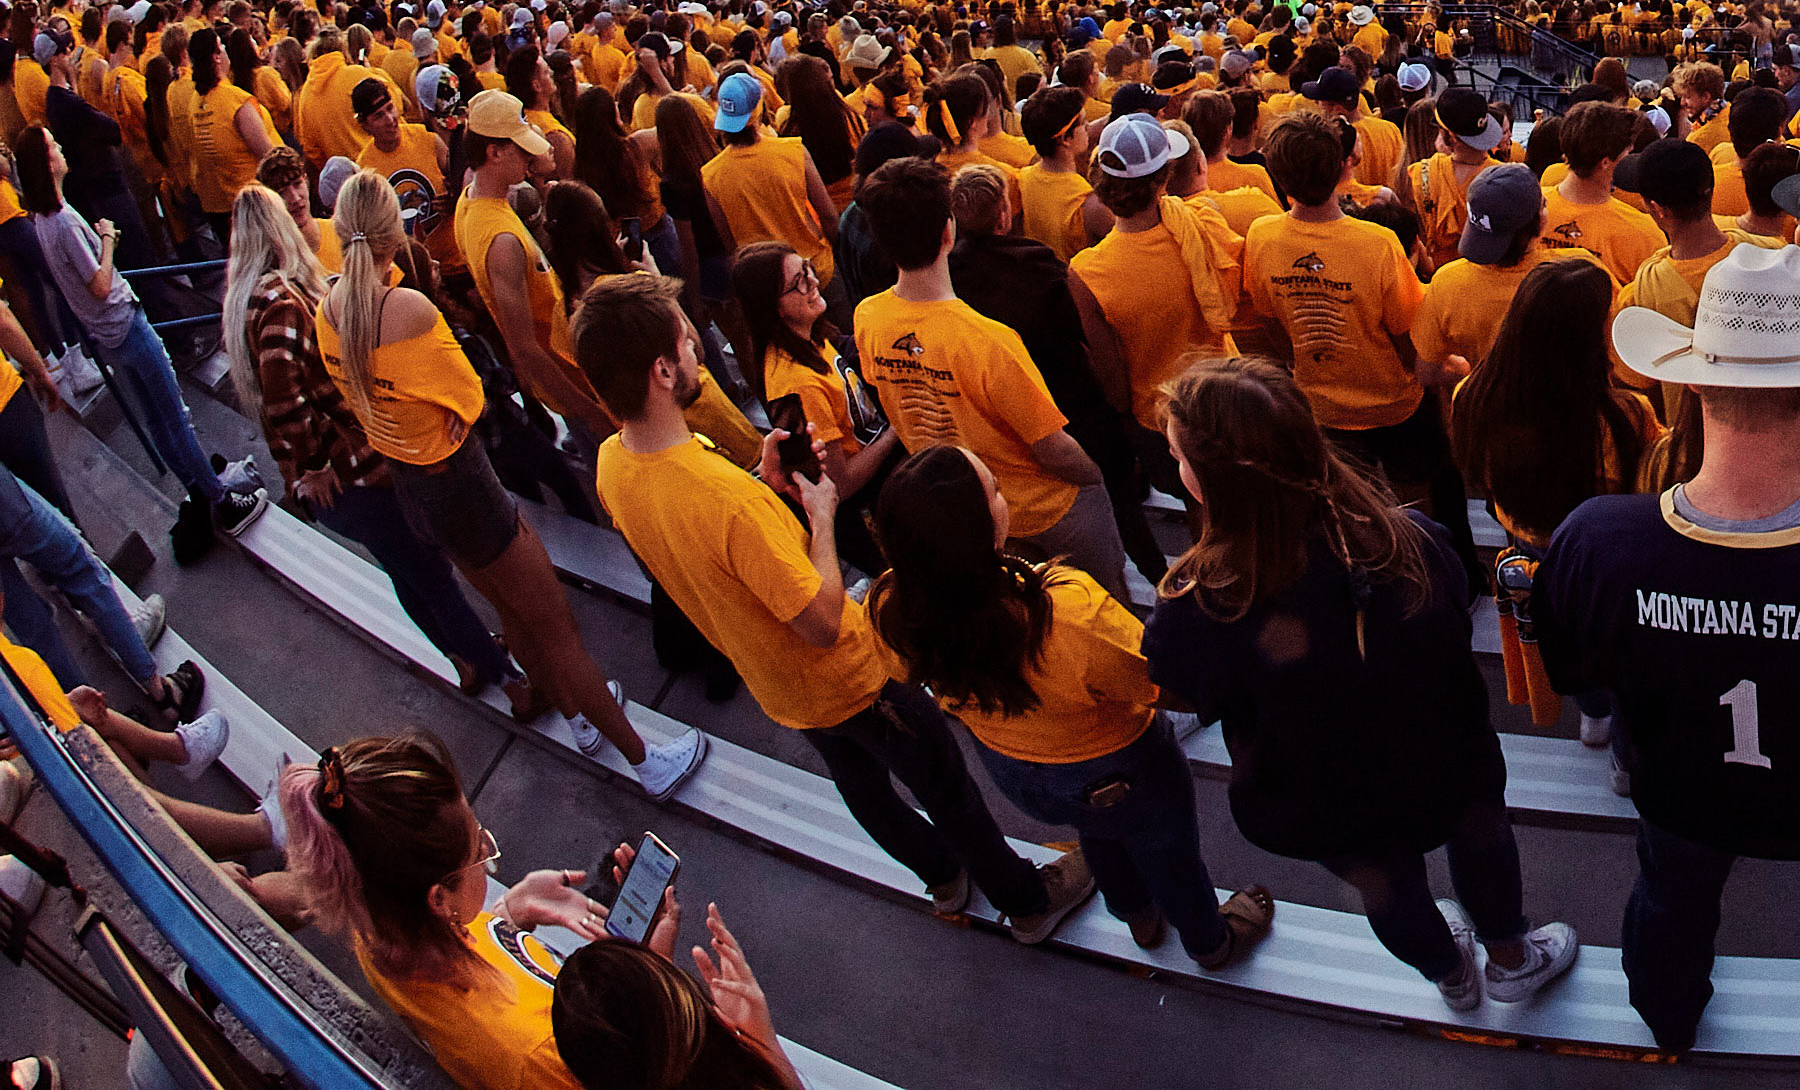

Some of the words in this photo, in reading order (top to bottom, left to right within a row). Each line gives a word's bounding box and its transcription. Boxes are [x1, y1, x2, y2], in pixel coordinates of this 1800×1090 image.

[1271, 276, 1320, 286] MONTANA
[1636, 589, 1757, 637] MONTANA
[1719, 679, 1772, 770] 1
